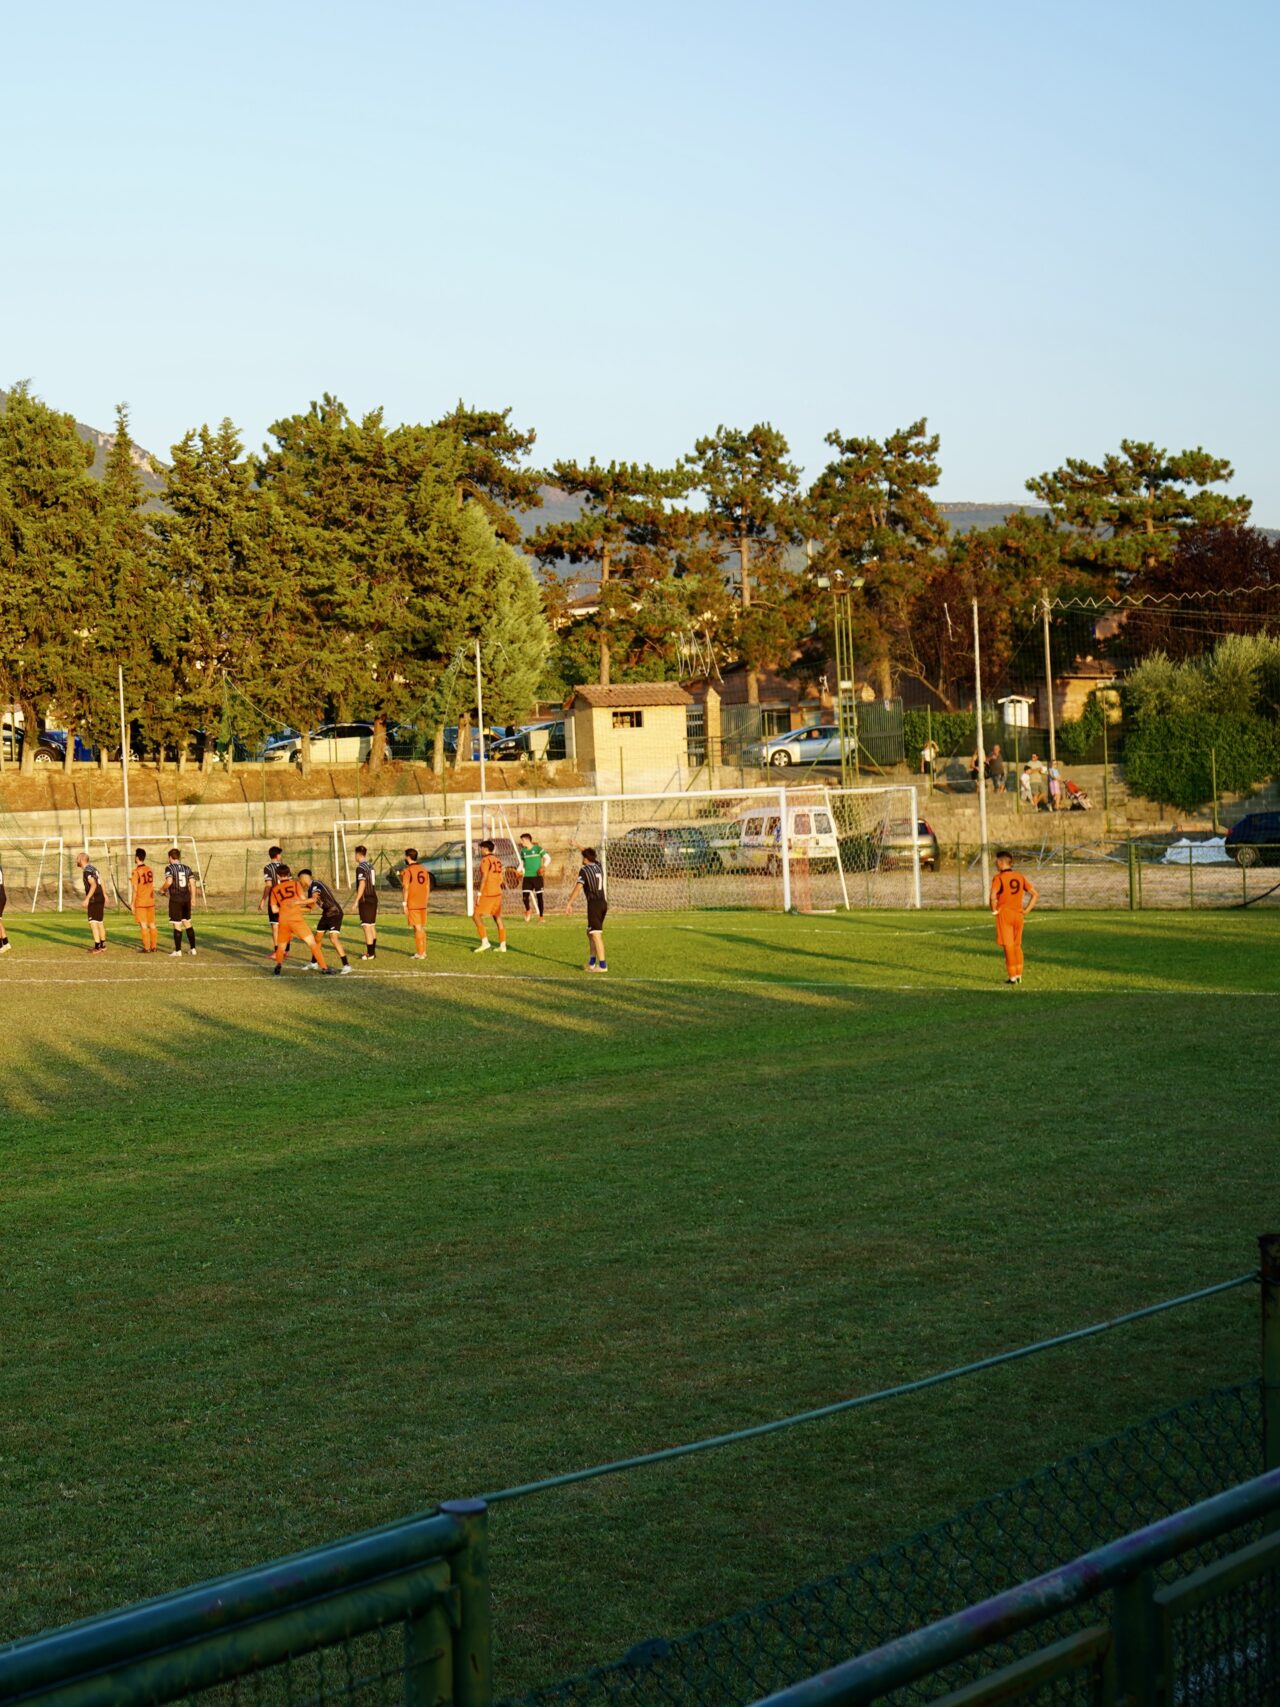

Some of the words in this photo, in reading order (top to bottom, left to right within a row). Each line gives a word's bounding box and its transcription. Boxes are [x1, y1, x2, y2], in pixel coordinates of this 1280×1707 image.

[142, 871, 153, 884] 18
[179, 872, 186, 887] 5
[417, 871, 425, 884] 6
[596, 873, 603, 890] 7
[277, 886, 295, 900] 15
[1009, 879, 1020, 894] 9
